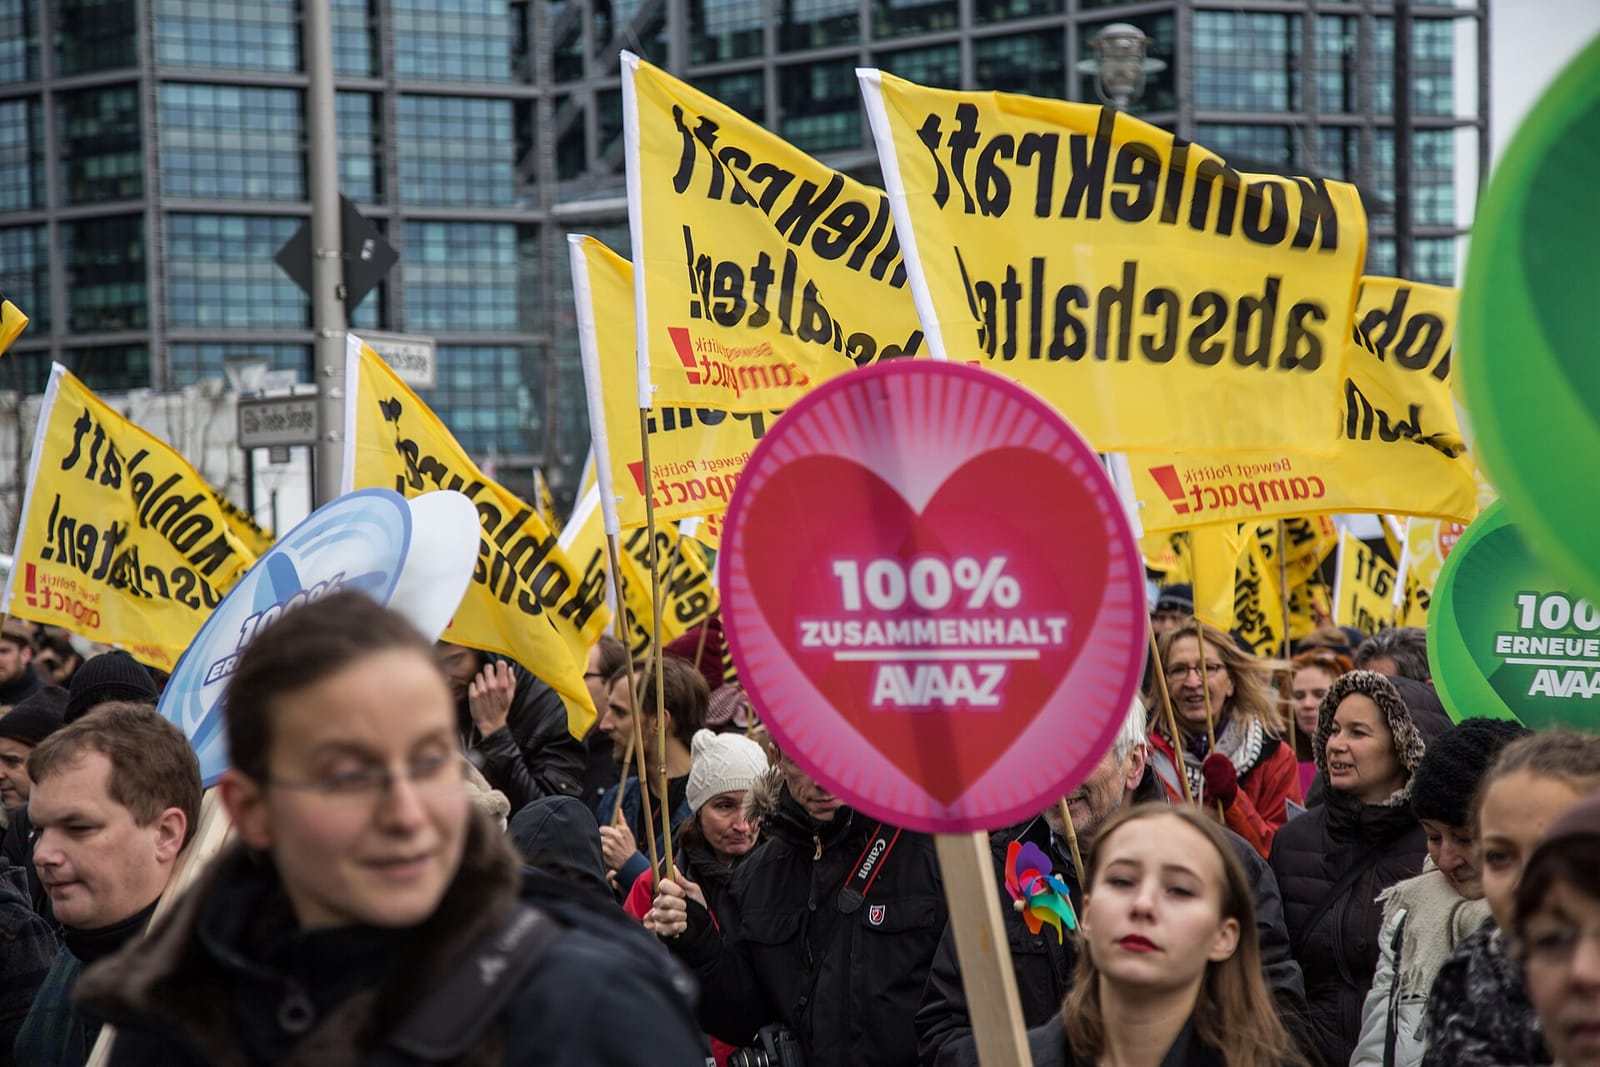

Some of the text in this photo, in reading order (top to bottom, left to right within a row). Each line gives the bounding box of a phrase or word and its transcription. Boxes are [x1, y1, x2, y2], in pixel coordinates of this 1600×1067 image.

[833, 557, 1021, 611] 100%
[801, 618, 1067, 647] ZUSAMMENHALT
[872, 664, 1006, 706] AVAAZ
[858, 838, 886, 879] Canon
